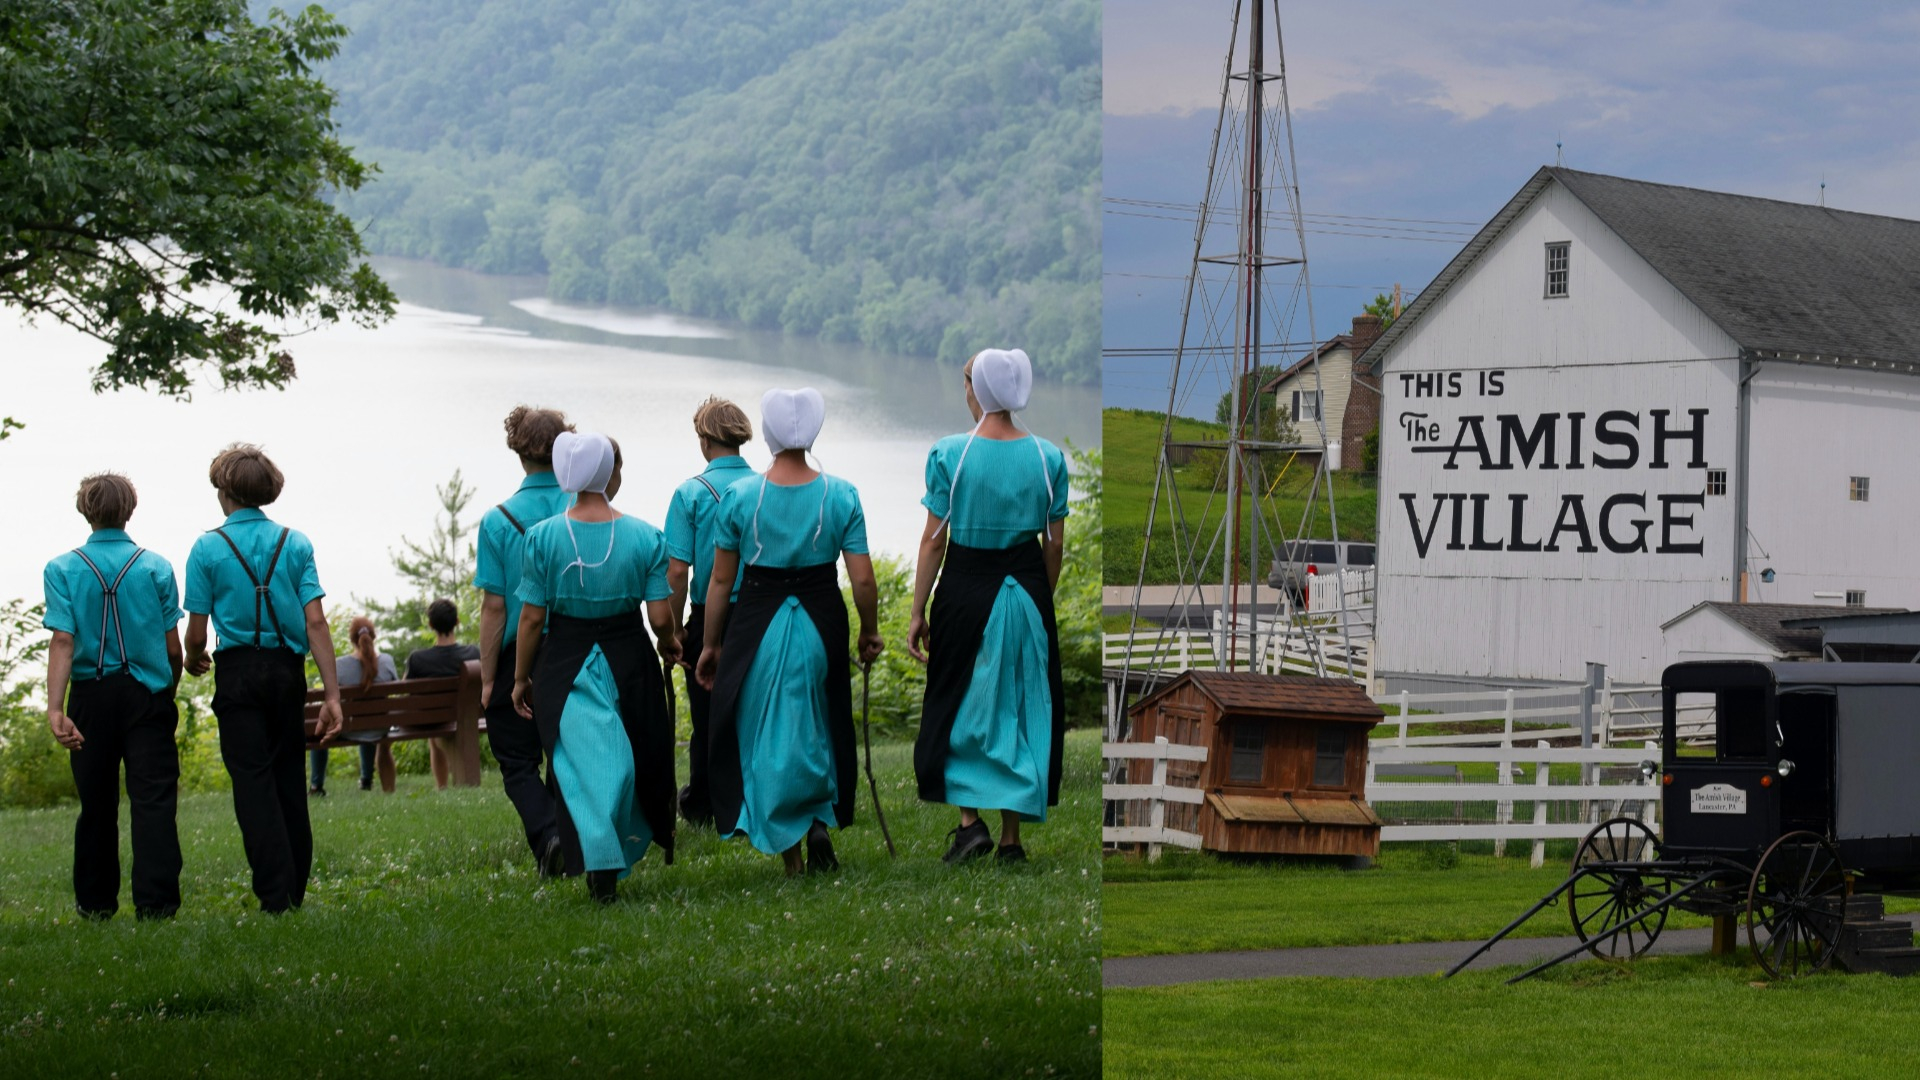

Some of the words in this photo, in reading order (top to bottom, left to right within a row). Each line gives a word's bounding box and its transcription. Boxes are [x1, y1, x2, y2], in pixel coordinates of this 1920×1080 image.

[1400, 372, 1462, 398] THIS
[1479, 370, 1505, 396] IS
[1399, 411, 1440, 442] The
[1443, 408, 1709, 470] AMISH
[1399, 490, 1705, 559] VILLAGE
[1695, 793, 1704, 801] The
[1706, 793, 1721, 801] Amish
[1722, 793, 1740, 803] Village
